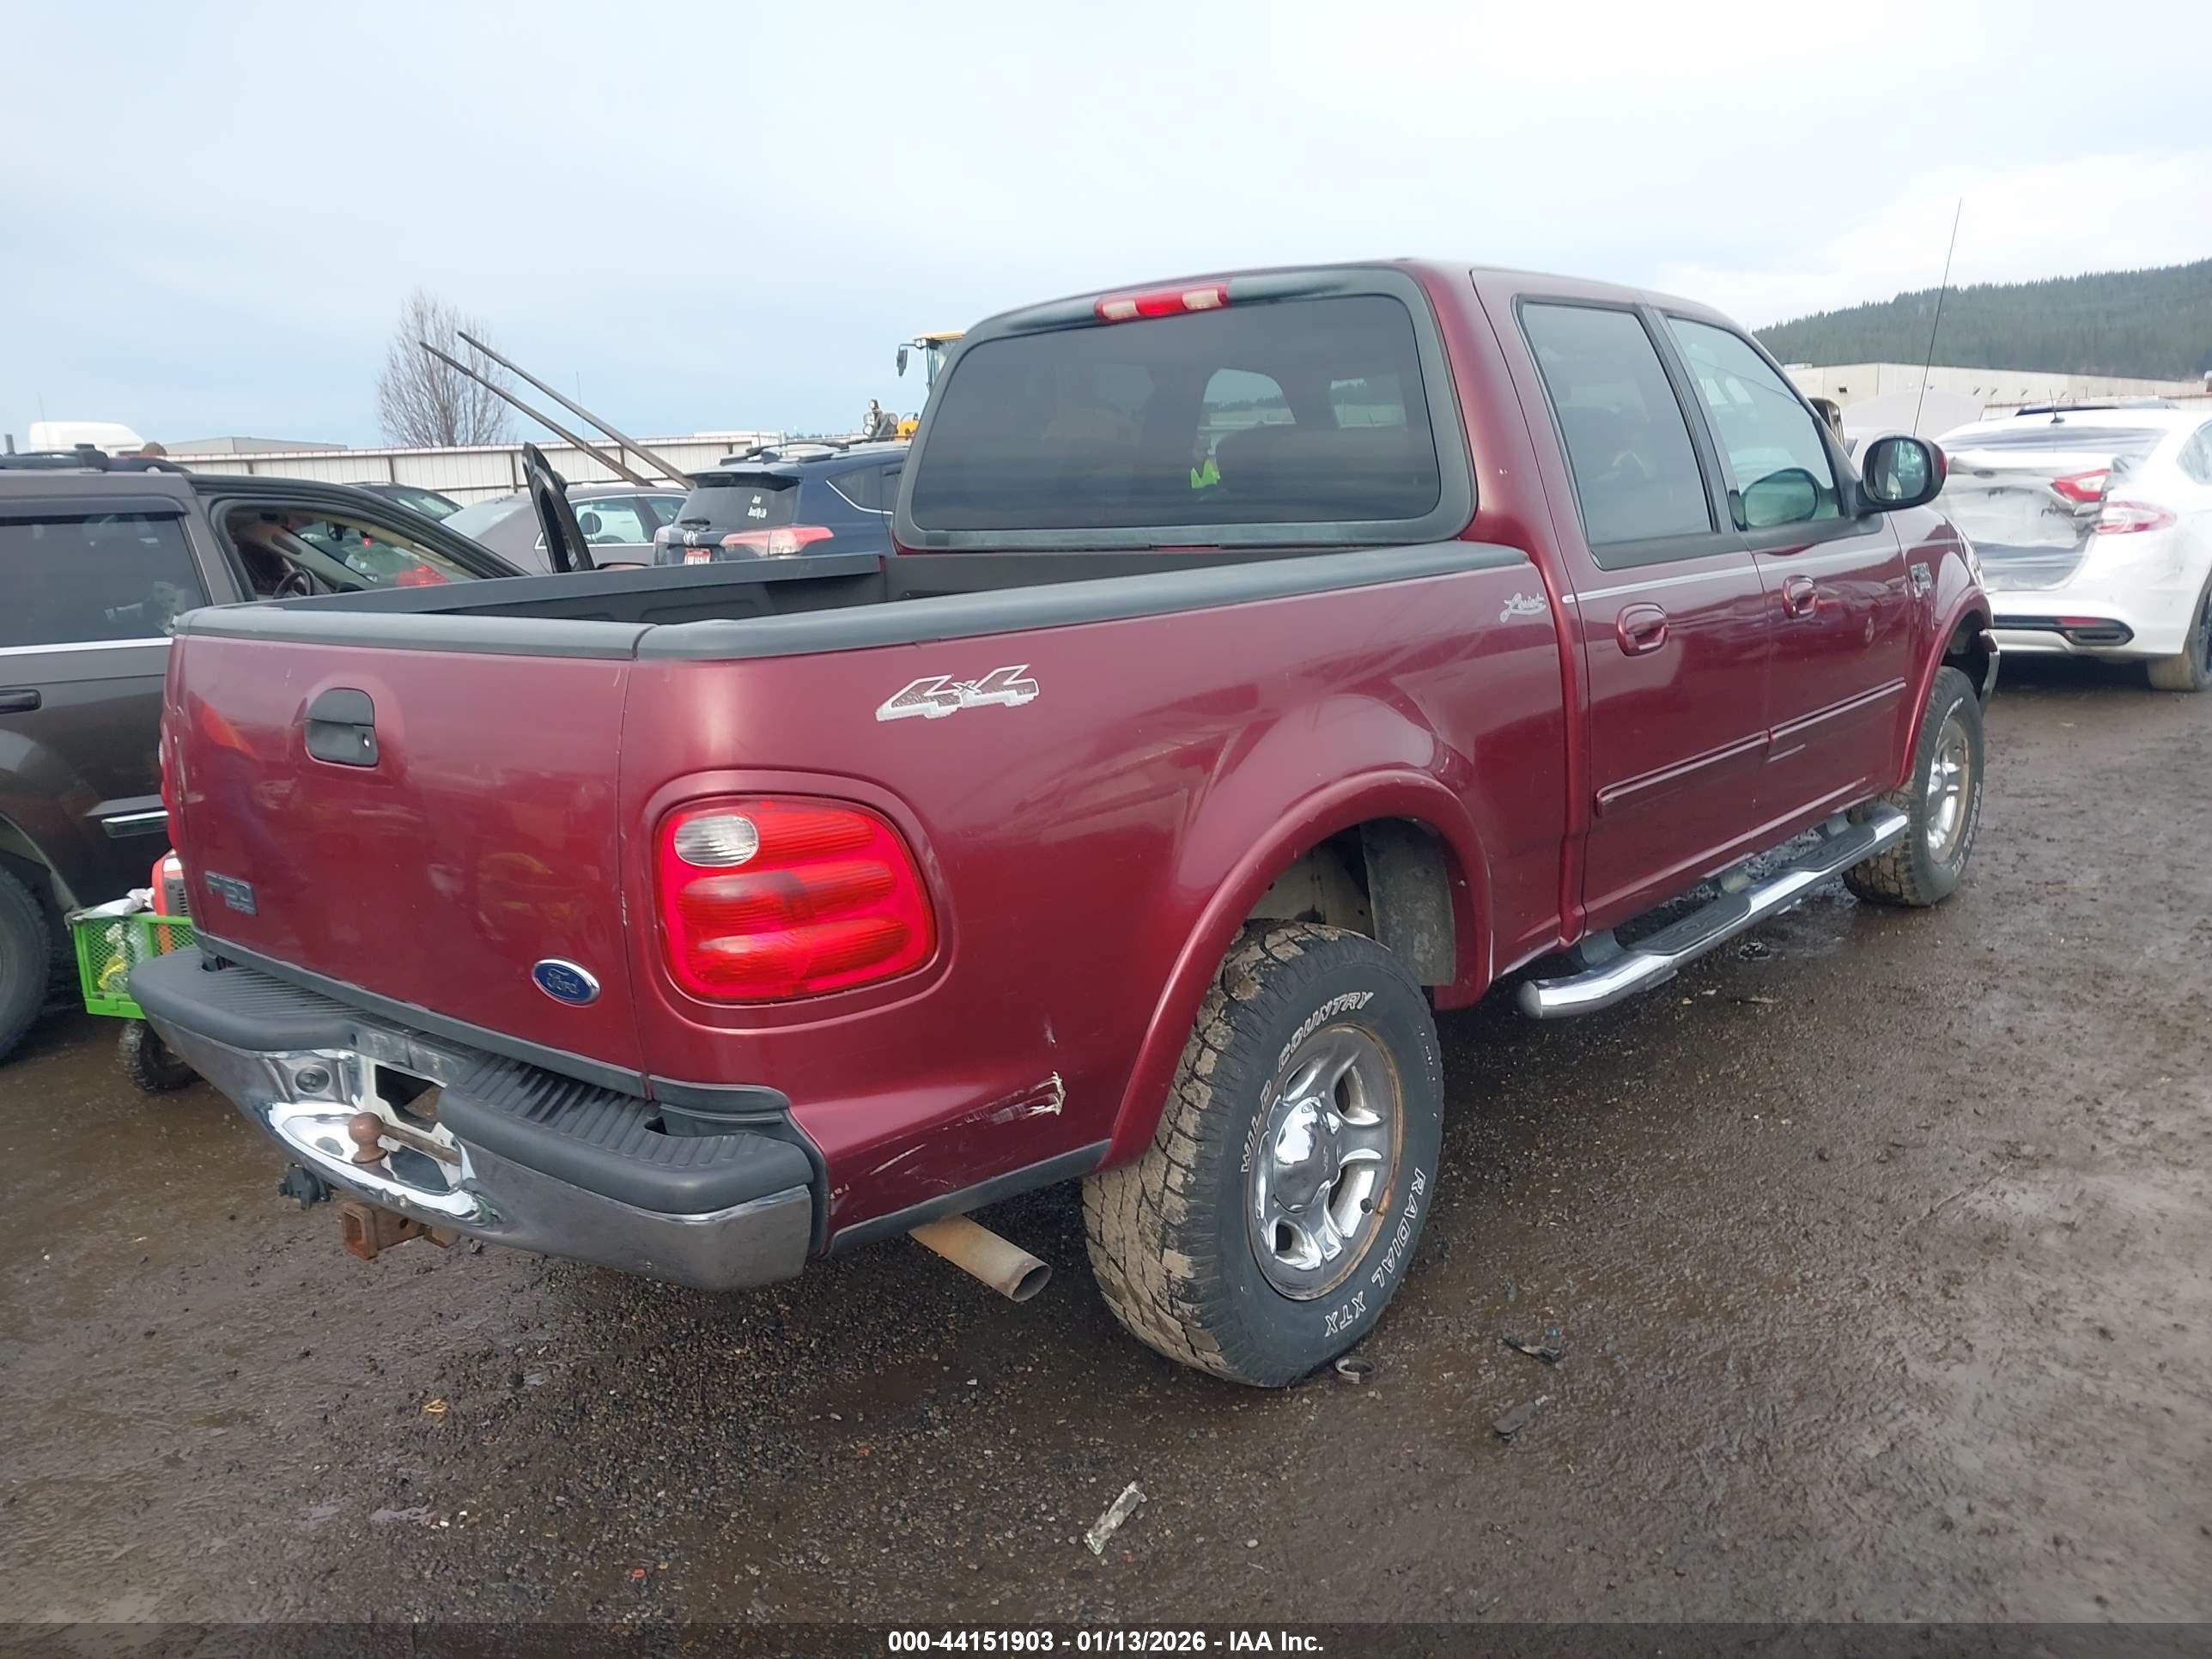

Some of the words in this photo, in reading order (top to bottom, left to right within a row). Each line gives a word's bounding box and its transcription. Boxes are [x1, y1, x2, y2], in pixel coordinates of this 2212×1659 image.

[875, 664, 1040, 721] 4x4
[1240, 1079, 1273, 1173] WILD
[1278, 991, 1375, 1073] COUNTRY
[1371, 1168, 1426, 1288] RADIAL
[1325, 1291, 1367, 1338] XTX
